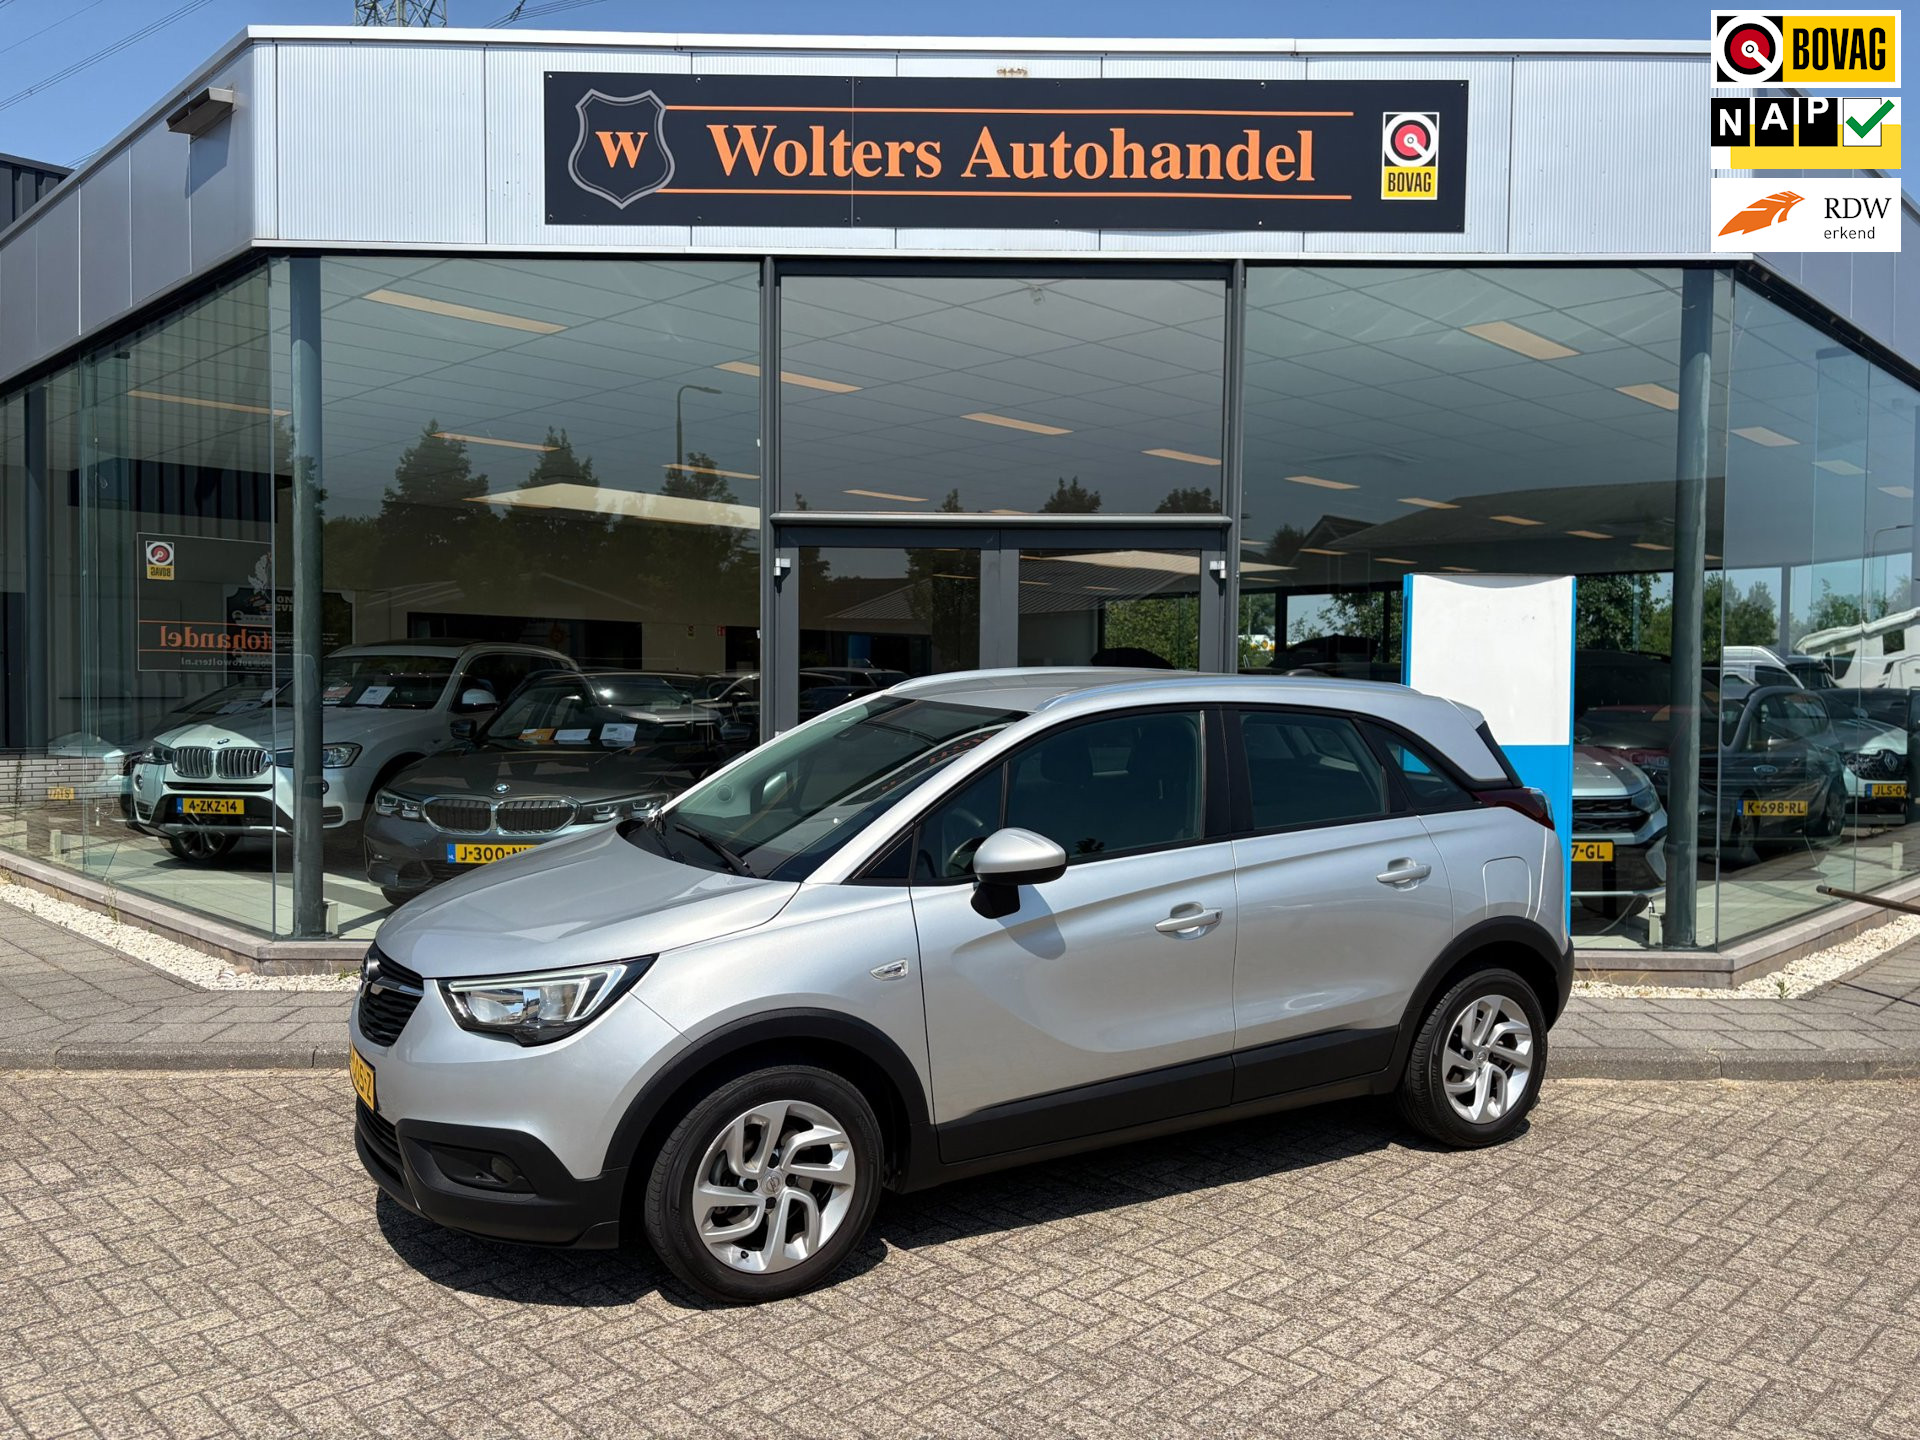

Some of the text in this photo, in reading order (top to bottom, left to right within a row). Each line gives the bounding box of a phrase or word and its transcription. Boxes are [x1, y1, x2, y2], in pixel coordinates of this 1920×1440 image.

[595, 131, 649, 169] W
[706, 124, 1316, 182] Wolters Autohandel
[1387, 170, 1432, 193] BOVAG
[188, 799, 237, 813] 4-ZKZ-14
[1747, 802, 1804, 814] K-698-RL
